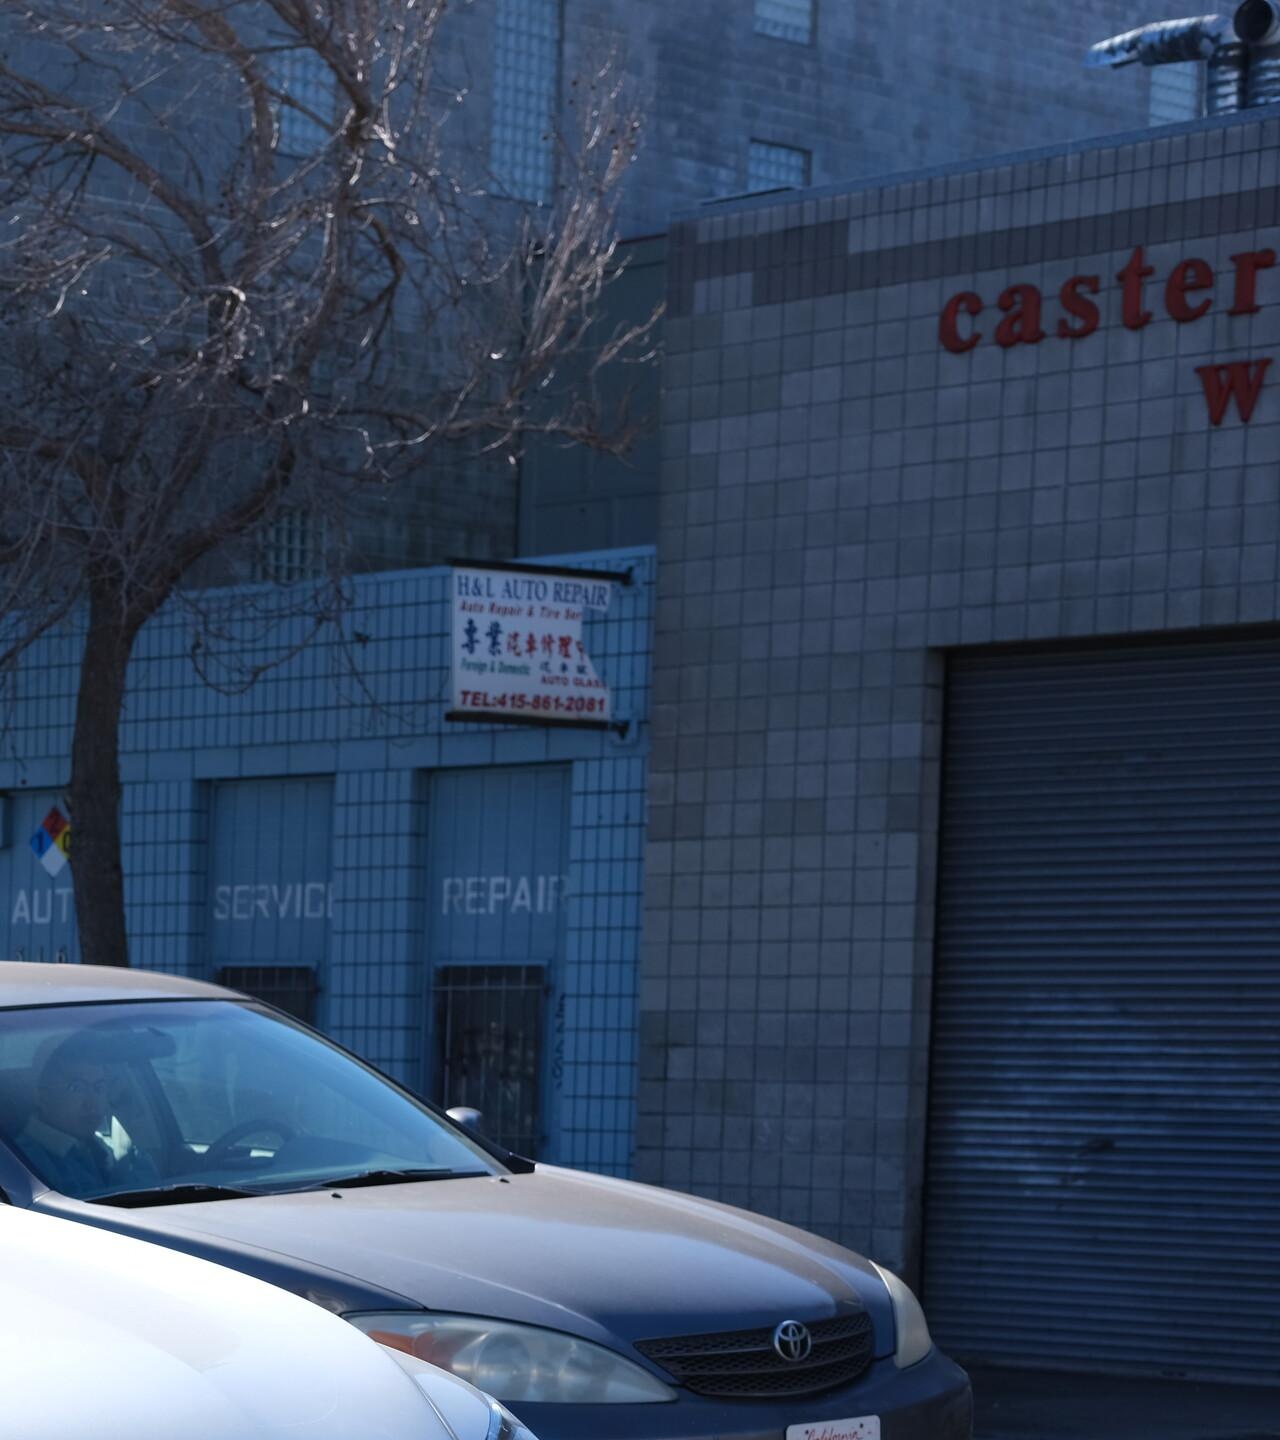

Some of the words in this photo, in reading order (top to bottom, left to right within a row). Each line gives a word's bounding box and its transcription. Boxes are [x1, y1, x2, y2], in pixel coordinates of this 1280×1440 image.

[939, 244, 1278, 355] caster
[457, 575, 495, 598] H&L
[501, 579, 547, 602] AUTO
[553, 582, 608, 606] REPAIR
[460, 600, 483, 613] Auto
[488, 602, 522, 618] Repair
[541, 675, 568, 687] AUTO
[11, 887, 74, 925] AUT
